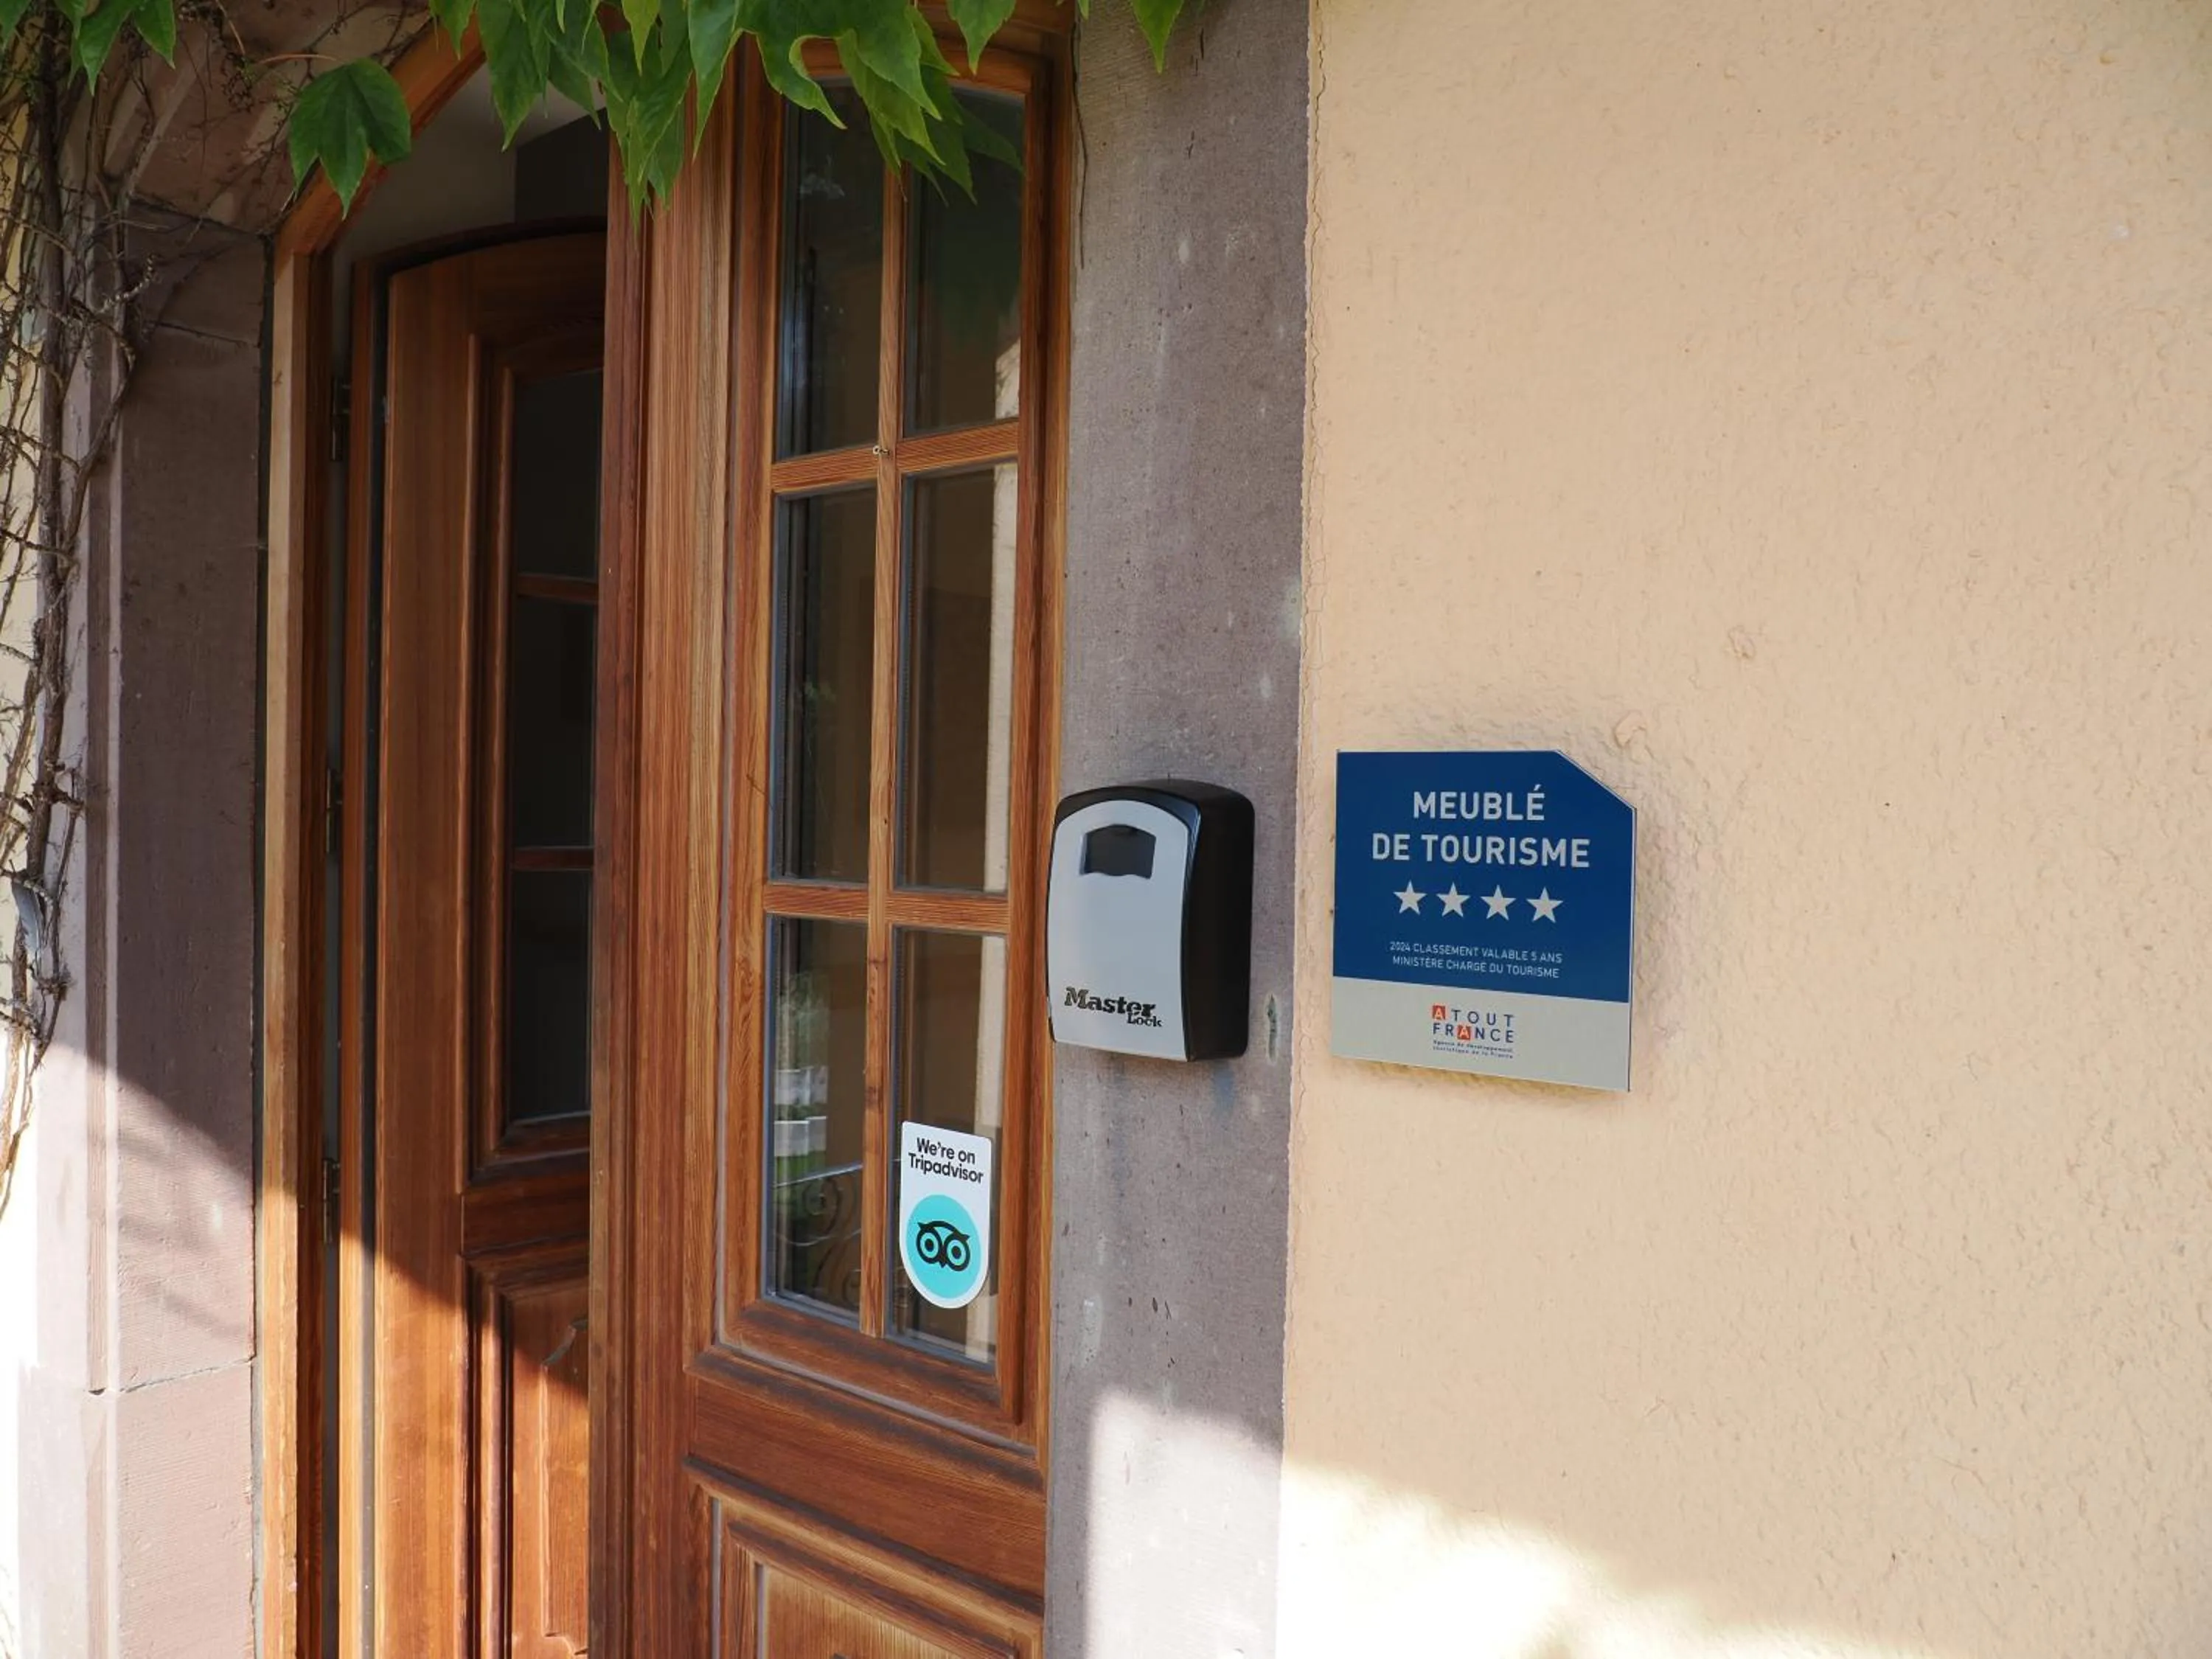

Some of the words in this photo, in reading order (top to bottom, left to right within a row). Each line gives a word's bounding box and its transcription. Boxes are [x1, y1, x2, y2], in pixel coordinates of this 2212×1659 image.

[1413, 785, 1545, 821] MEUBLÉ
[1372, 833, 1411, 861] DE
[1421, 834, 1590, 868] TOURISME
[1390, 941, 1411, 952] 2024
[1413, 943, 1478, 957] CLASSEMENT
[1481, 947, 1529, 961] VALABLE
[1531, 951, 1537, 961] 5
[1540, 952, 1563, 964] ANS
[1489, 962, 1504, 974] DU
[1506, 964, 1559, 978] TOURISME
[1064, 987, 1156, 1018] Master
[1127, 1011, 1163, 1027] Lock
[1433, 1006, 1514, 1027] ATOUT
[1433, 1023, 1514, 1043] FRANCE
[908, 1152, 984, 1184] Tripadvisor
[958, 1150, 975, 1165] on
